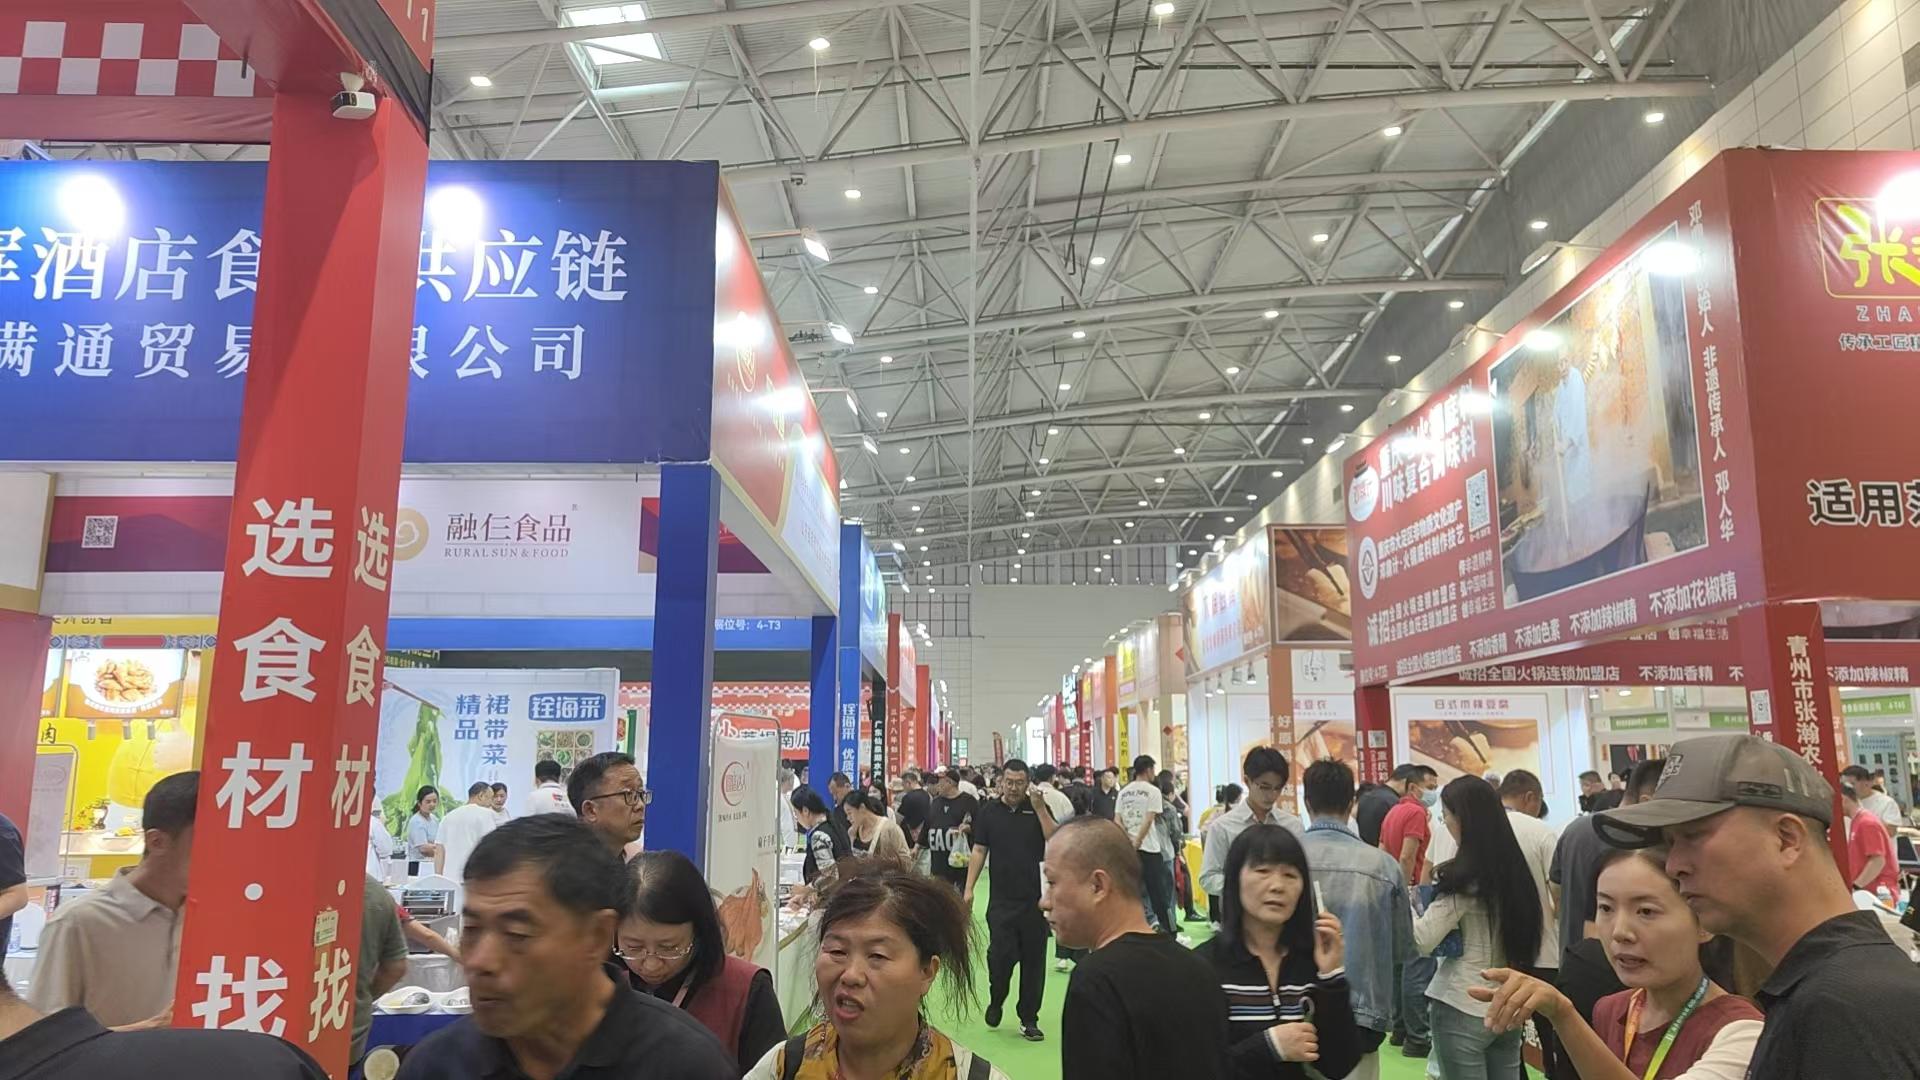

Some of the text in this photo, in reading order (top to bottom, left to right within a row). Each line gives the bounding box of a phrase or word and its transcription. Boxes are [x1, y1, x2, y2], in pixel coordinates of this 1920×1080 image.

[1837, 203, 1920, 289] 张
[1714, 469, 1736, 543] 邓人华
[533, 548, 569, 558] FOOD
[1569, 598, 1637, 636] 不添加辣椒精
[1649, 571, 1738, 618] 不添加花椒精
[1514, 618, 1561, 648] 不添加色素
[1639, 666, 1714, 682] 不添加香精
[454, 694, 482, 740] 精品
[481, 693, 511, 766] 裙带菜
